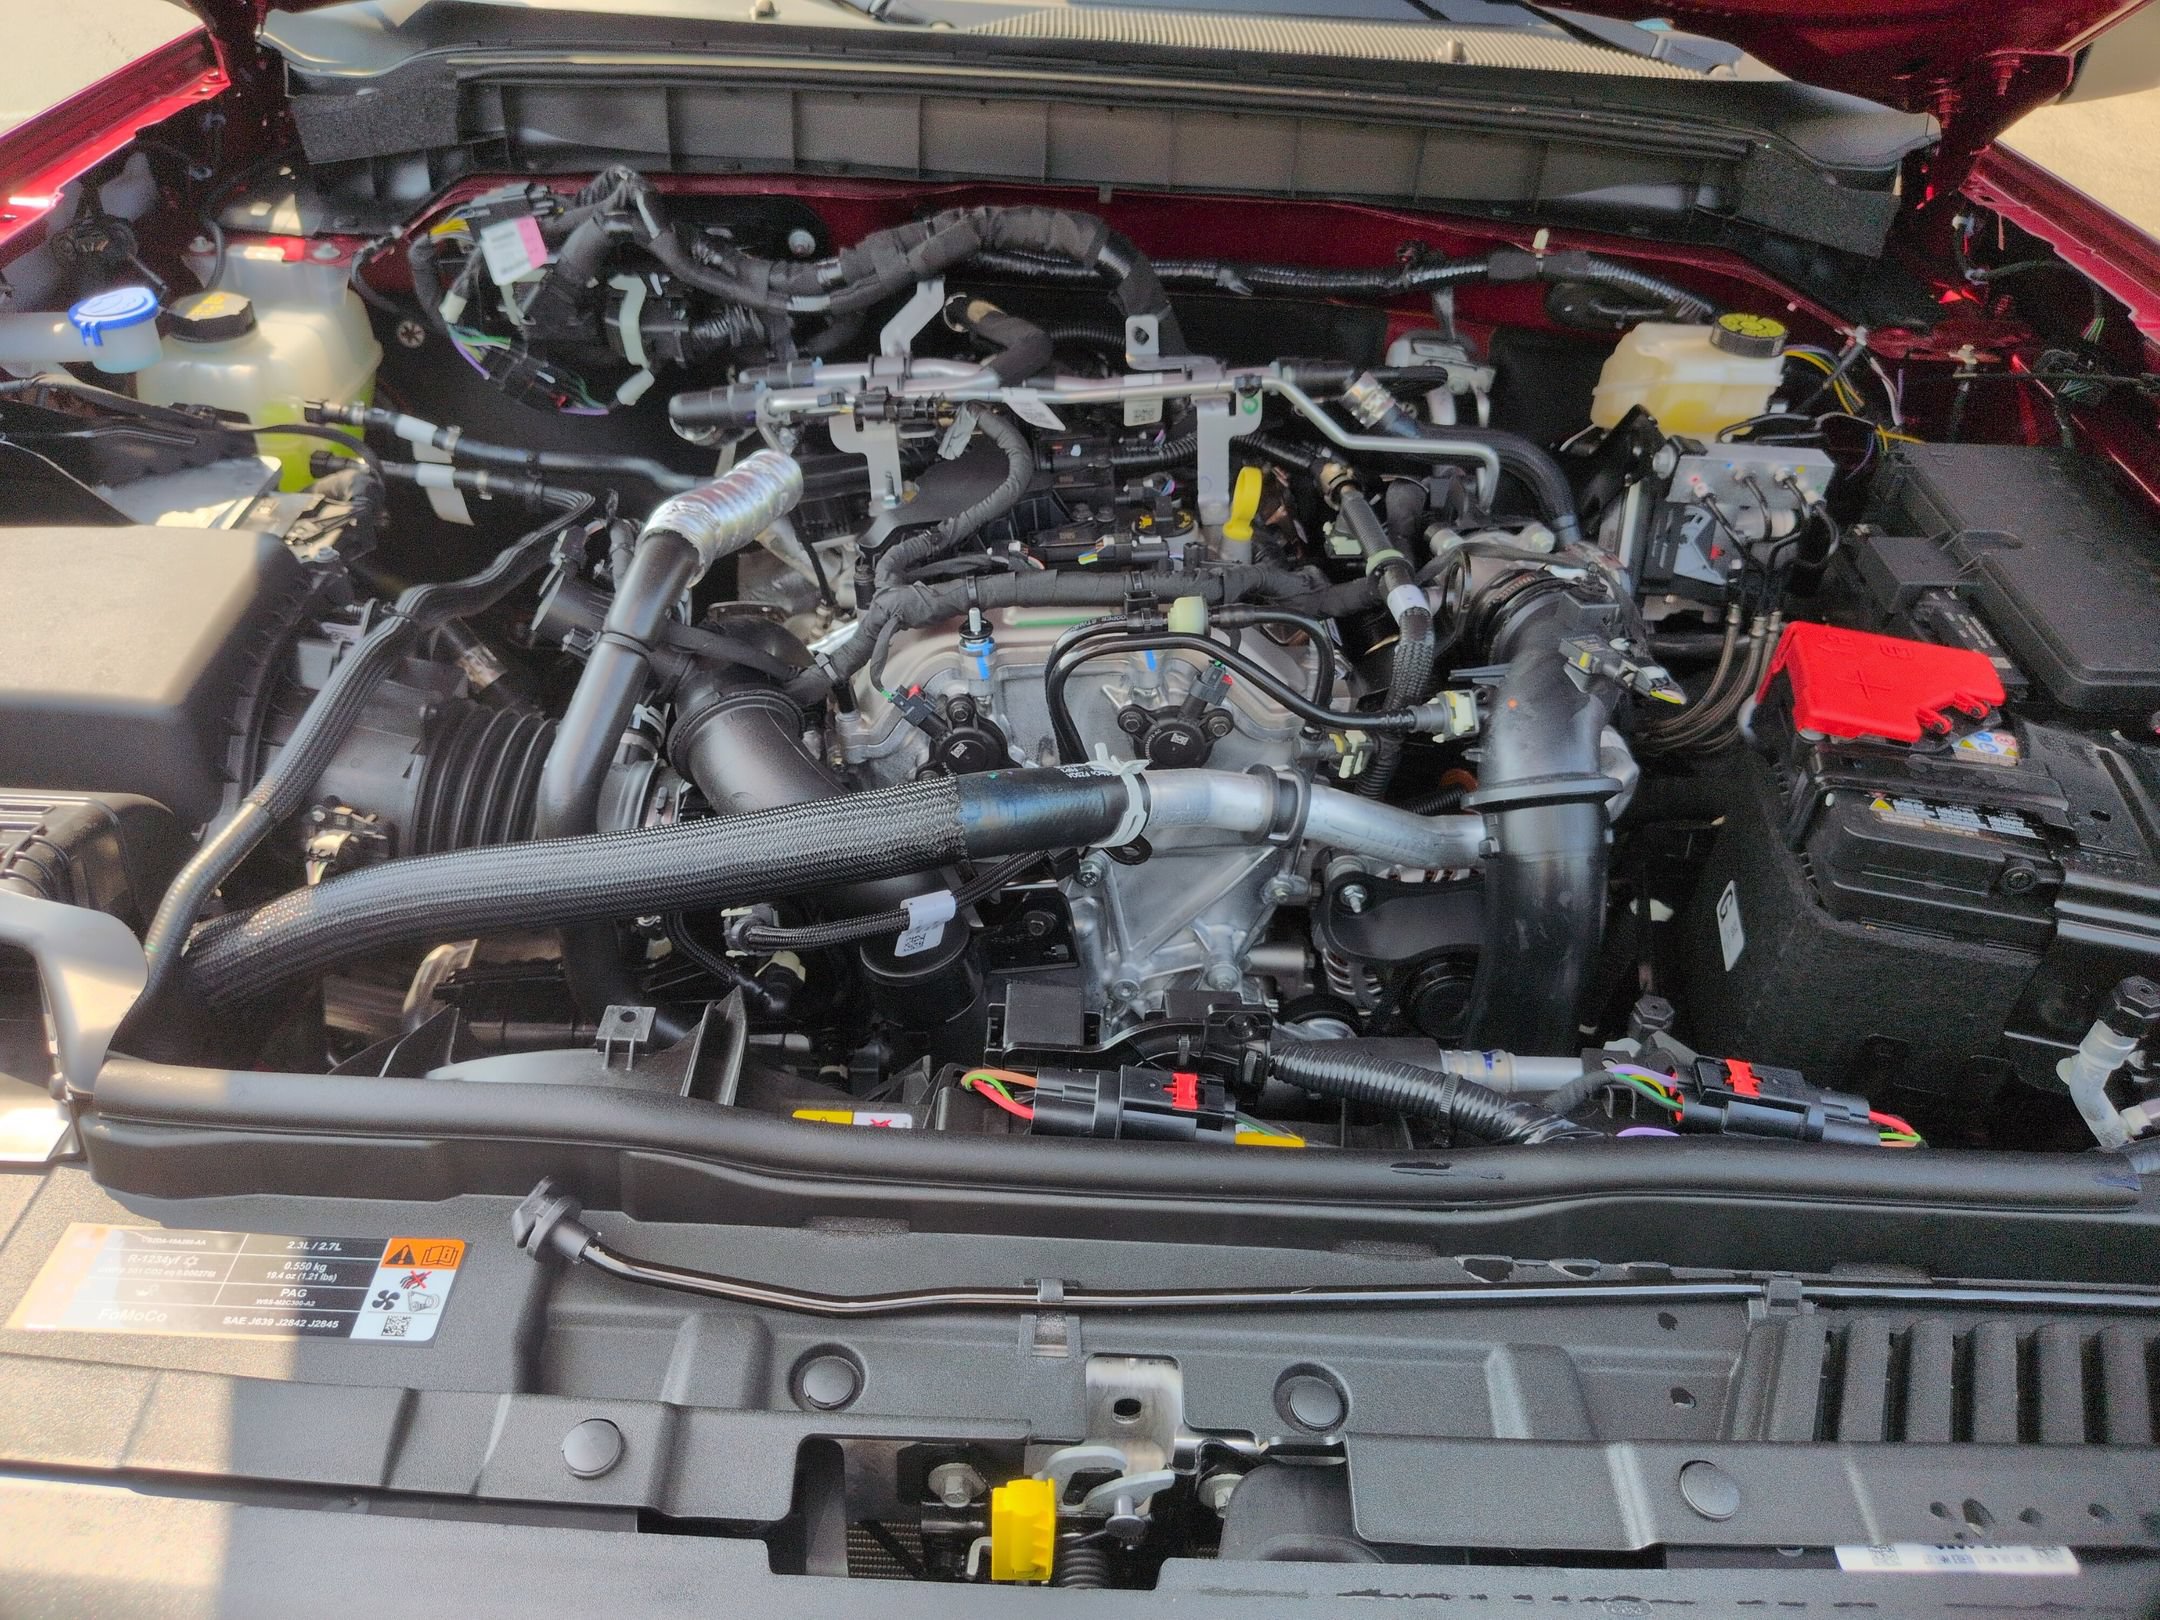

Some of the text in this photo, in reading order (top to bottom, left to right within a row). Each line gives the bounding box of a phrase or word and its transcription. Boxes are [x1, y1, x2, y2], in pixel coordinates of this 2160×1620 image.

[286, 1241, 310, 1250] 2.3L
[318, 1242, 342, 1251] 2.7L
[128, 1255, 181, 1265] R-1234yf
[283, 1261, 328, 1273] 0.550 kg
[266, 1272, 284, 1280] 19.4
[297, 1273, 318, 1281] (1.21
[319, 1274, 338, 1282] lbs)
[280, 1288, 308, 1298] PAG
[98, 1309, 167, 1323] FoMoCo
[223, 1316, 340, 1329] SAE J639 J2842 J2845
